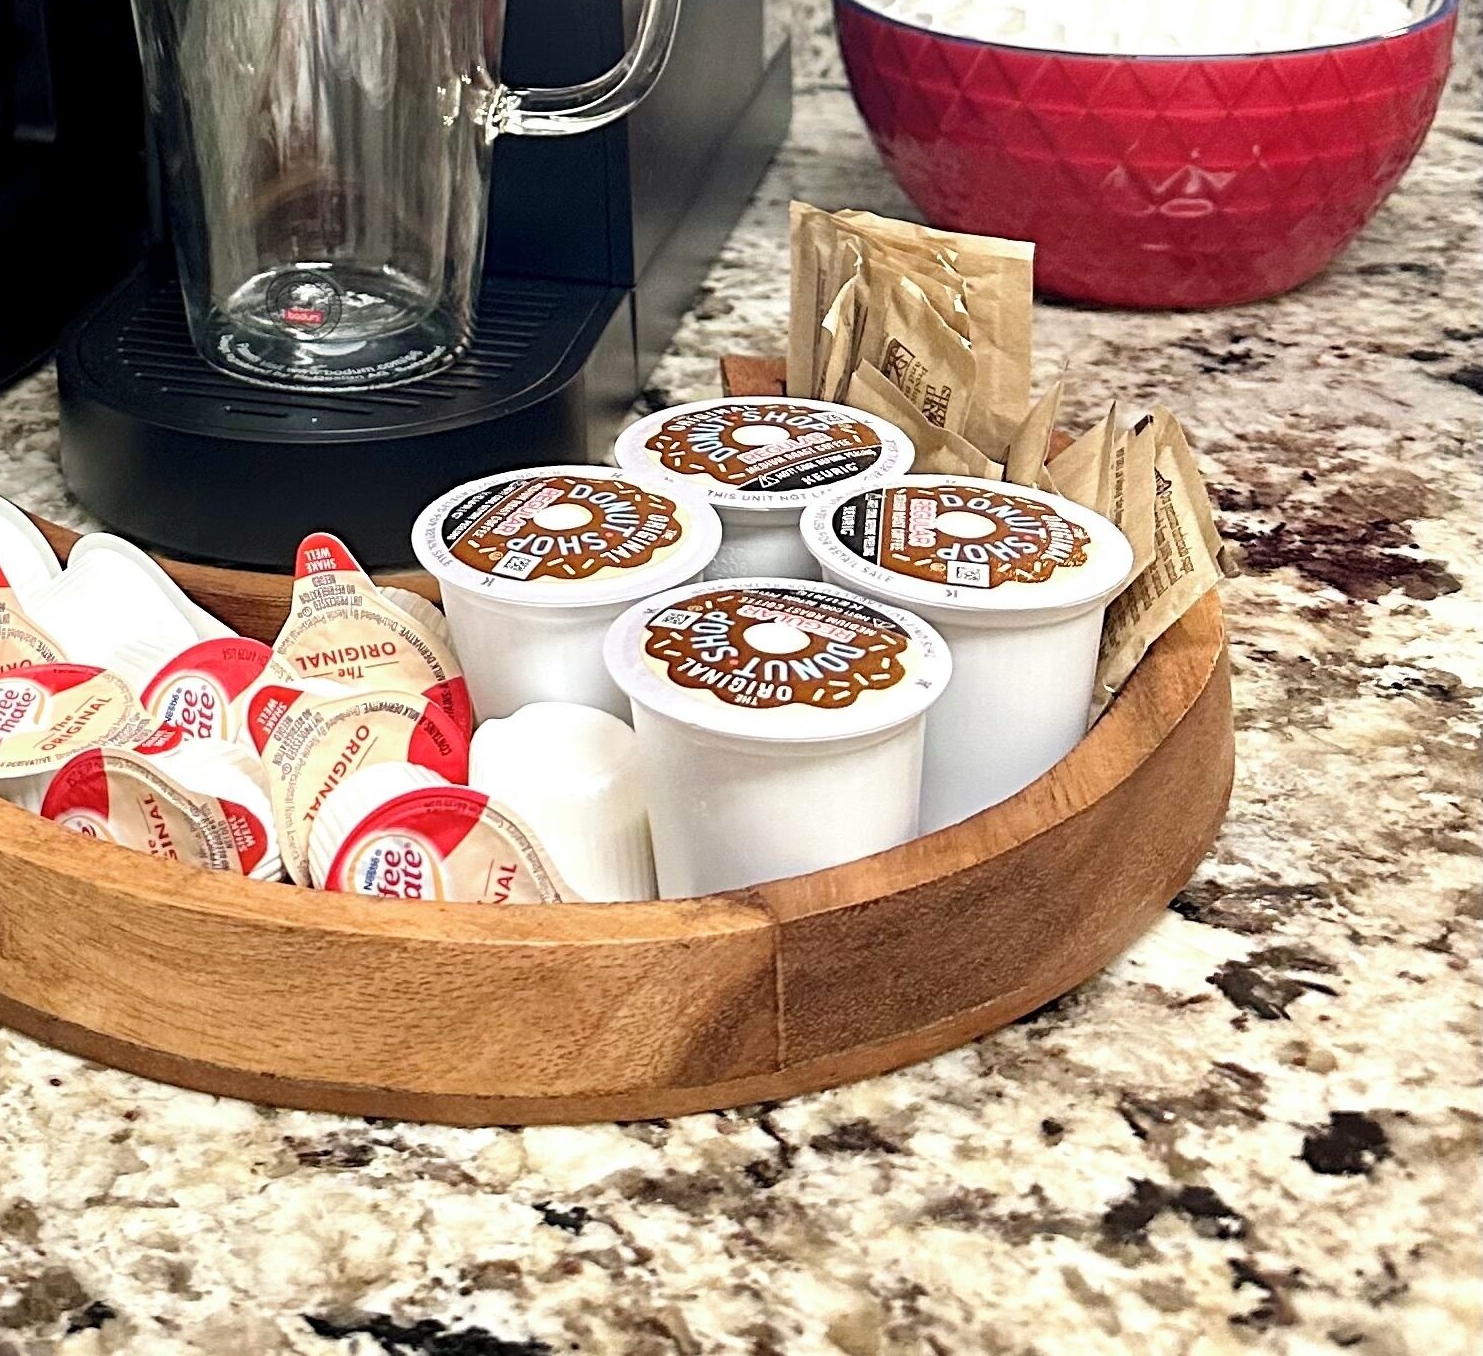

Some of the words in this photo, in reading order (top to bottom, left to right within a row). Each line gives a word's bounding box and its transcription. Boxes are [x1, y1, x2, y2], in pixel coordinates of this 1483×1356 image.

[687, 415, 739, 463] DONUT
[742, 410, 831, 432] SHOP
[740, 432, 831, 464] REGULAR
[815, 438, 854, 454] COFFEE
[801, 461, 859, 486] KEURIG
[567, 484, 640, 538] DONUT
[707, 489, 737, 500] THIS
[742, 494, 774, 502] UNIT
[779, 494, 809, 502] NOT
[493, 488, 564, 536] REGULAR
[909, 499, 937, 547] REGULAR
[939, 494, 1047, 539] DONUT
[304, 546, 331, 563] WELL
[506, 532, 608, 556] SHOP
[600, 514, 670, 563] ORIGINAL
[937, 536, 1038, 563] SHOP
[306, 558, 337, 574] SHAKE
[862, 567, 894, 582] SALE
[738, 596, 785, 612] COFFEE
[785, 603, 827, 623] ROAST
[690, 611, 740, 662] SHOP
[738, 605, 856, 643] REGULAR
[827, 617, 877, 637] MEDIUM
[295, 642, 396, 671] ORIGINAL
[338, 666, 364, 679] The
[430, 656, 446, 682] MILK
[732, 642, 866, 682] DONUT
[677, 657, 793, 701] ORIGINAL
[179, 689, 199, 739] fee
[198, 692, 216, 739] ate
[256, 698, 278, 725] WELL
[735, 694, 758, 706] THE
[41, 697, 113, 751] ORIGINAL
[51, 715, 73, 733] The
[263, 701, 288, 735] SHAKE
[273, 715, 294, 742] NEEDED
[302, 725, 370, 821] ORIGINAL
[142, 793, 178, 861] GINAL
[219, 815, 248, 852] SHAKE
[237, 816, 257, 848] WELL
[377, 849, 401, 898] fee
[404, 849, 423, 899] ate
